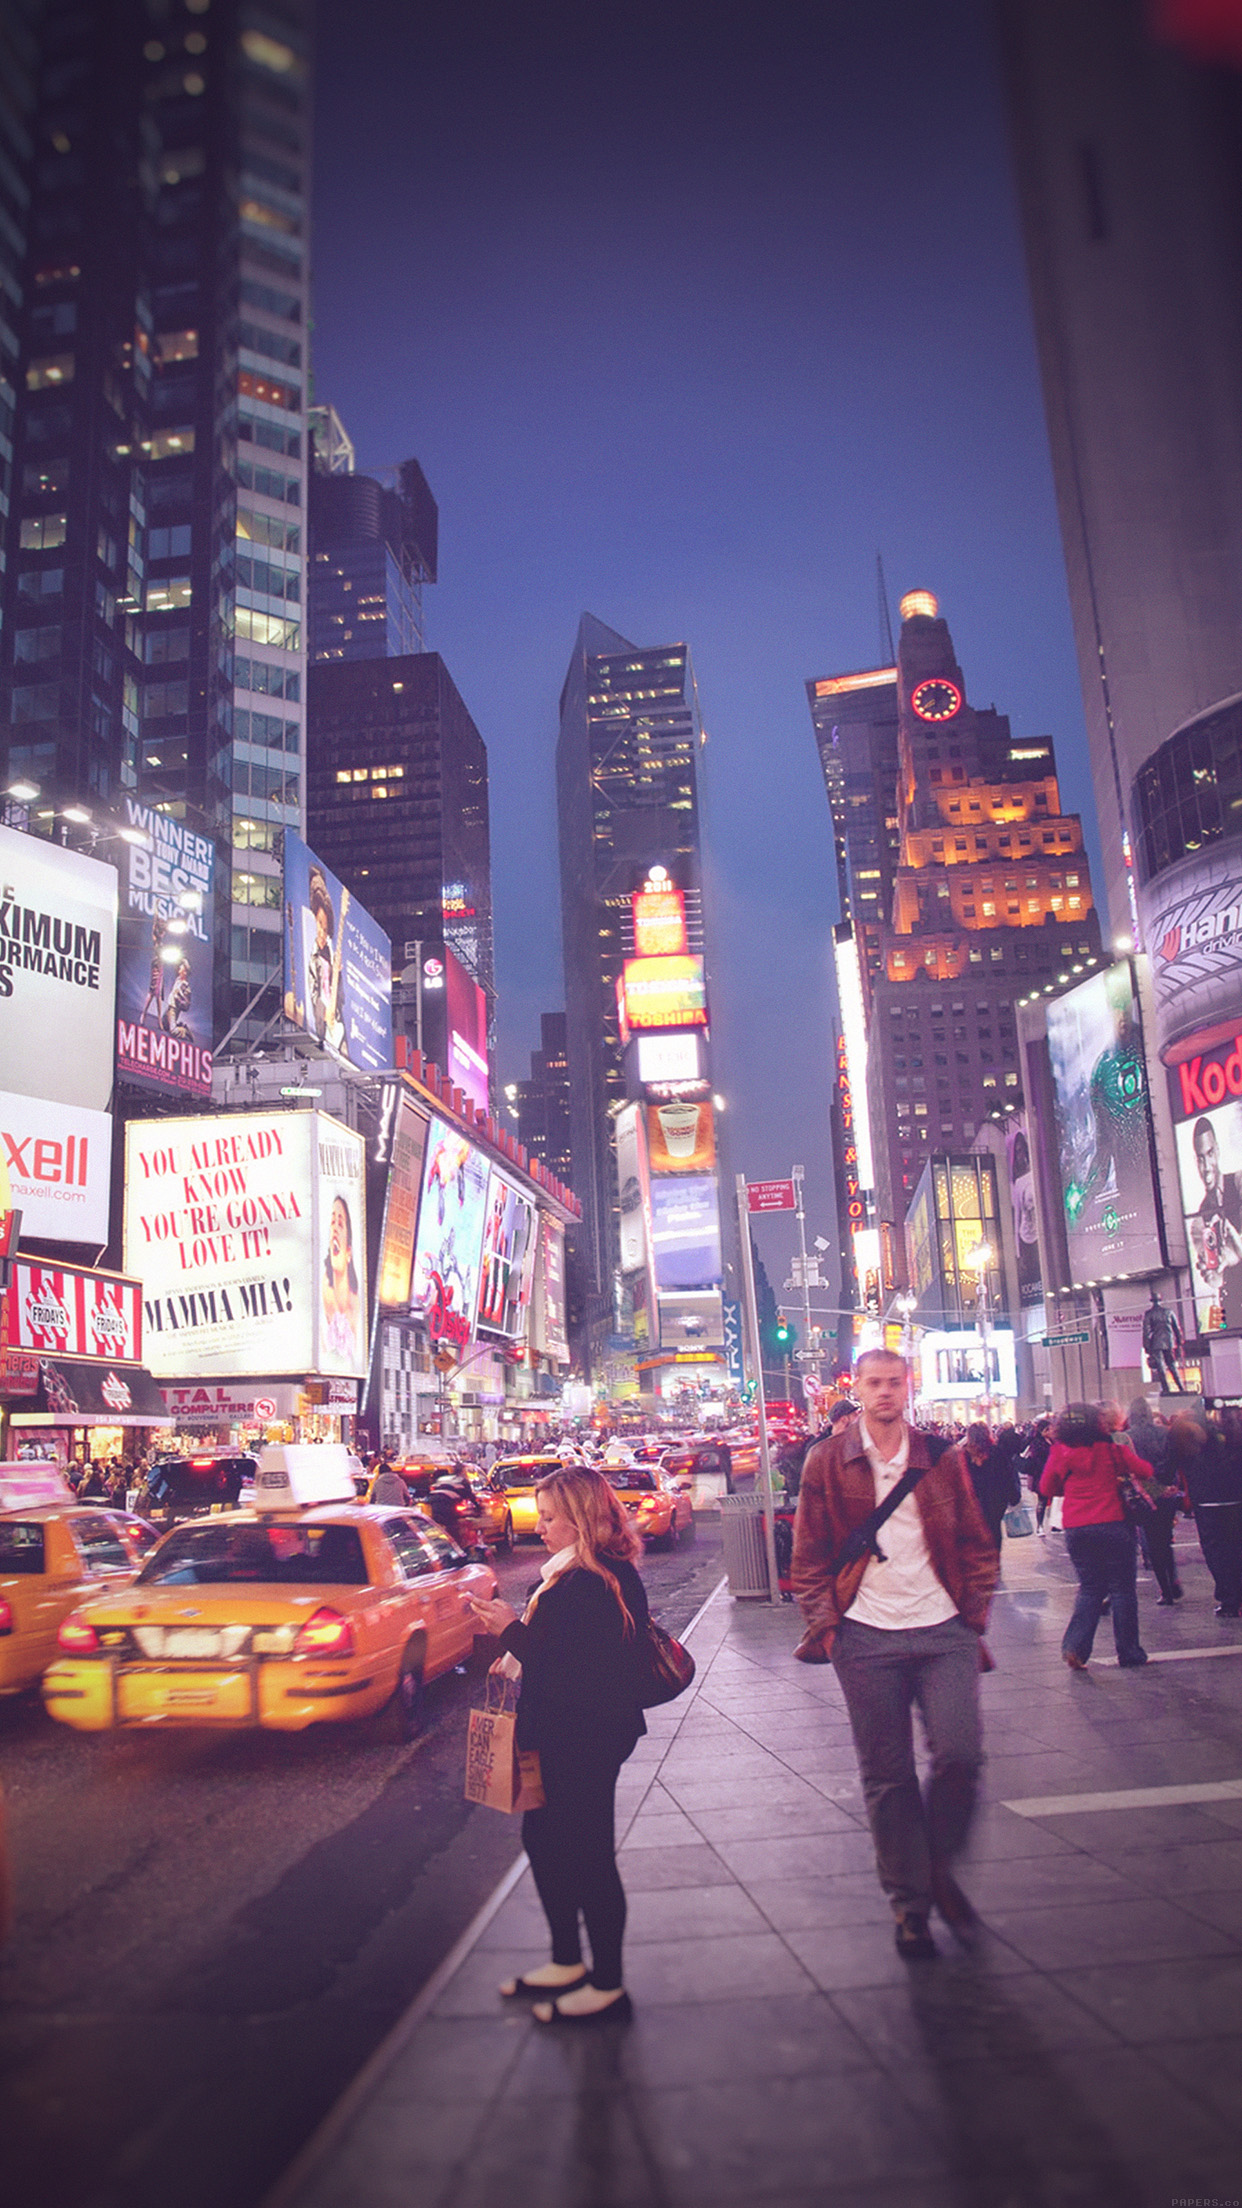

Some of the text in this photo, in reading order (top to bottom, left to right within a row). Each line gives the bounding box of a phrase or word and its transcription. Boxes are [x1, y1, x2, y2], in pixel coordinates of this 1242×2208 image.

[127, 798, 213, 866] WINNER!
[129, 845, 209, 917] BEST
[128, 885, 209, 942] MUSICAL
[1179, 905, 1242, 952] Han
[629, 1009, 707, 1028] TOSHIBA
[118, 1018, 213, 1085] MEMPHIS
[1179, 1034, 1242, 1115] Kod
[838, 1035, 853, 1128] ERNST
[1, 1132, 88, 1187] xell
[139, 1127, 284, 1178] YOU ALREADY
[845, 1146, 857, 1163] &
[183, 1166, 248, 1203] KNOW
[761, 1183, 790, 1192] STOPPING
[140, 1191, 301, 1242] YOU'RE GONNA
[178, 1226, 271, 1269] LOVE IT!
[144, 1289, 234, 1334] MAMMA
[239, 1277, 293, 1319] MIA!
[171, 1402, 254, 1414] COMPUTERS
